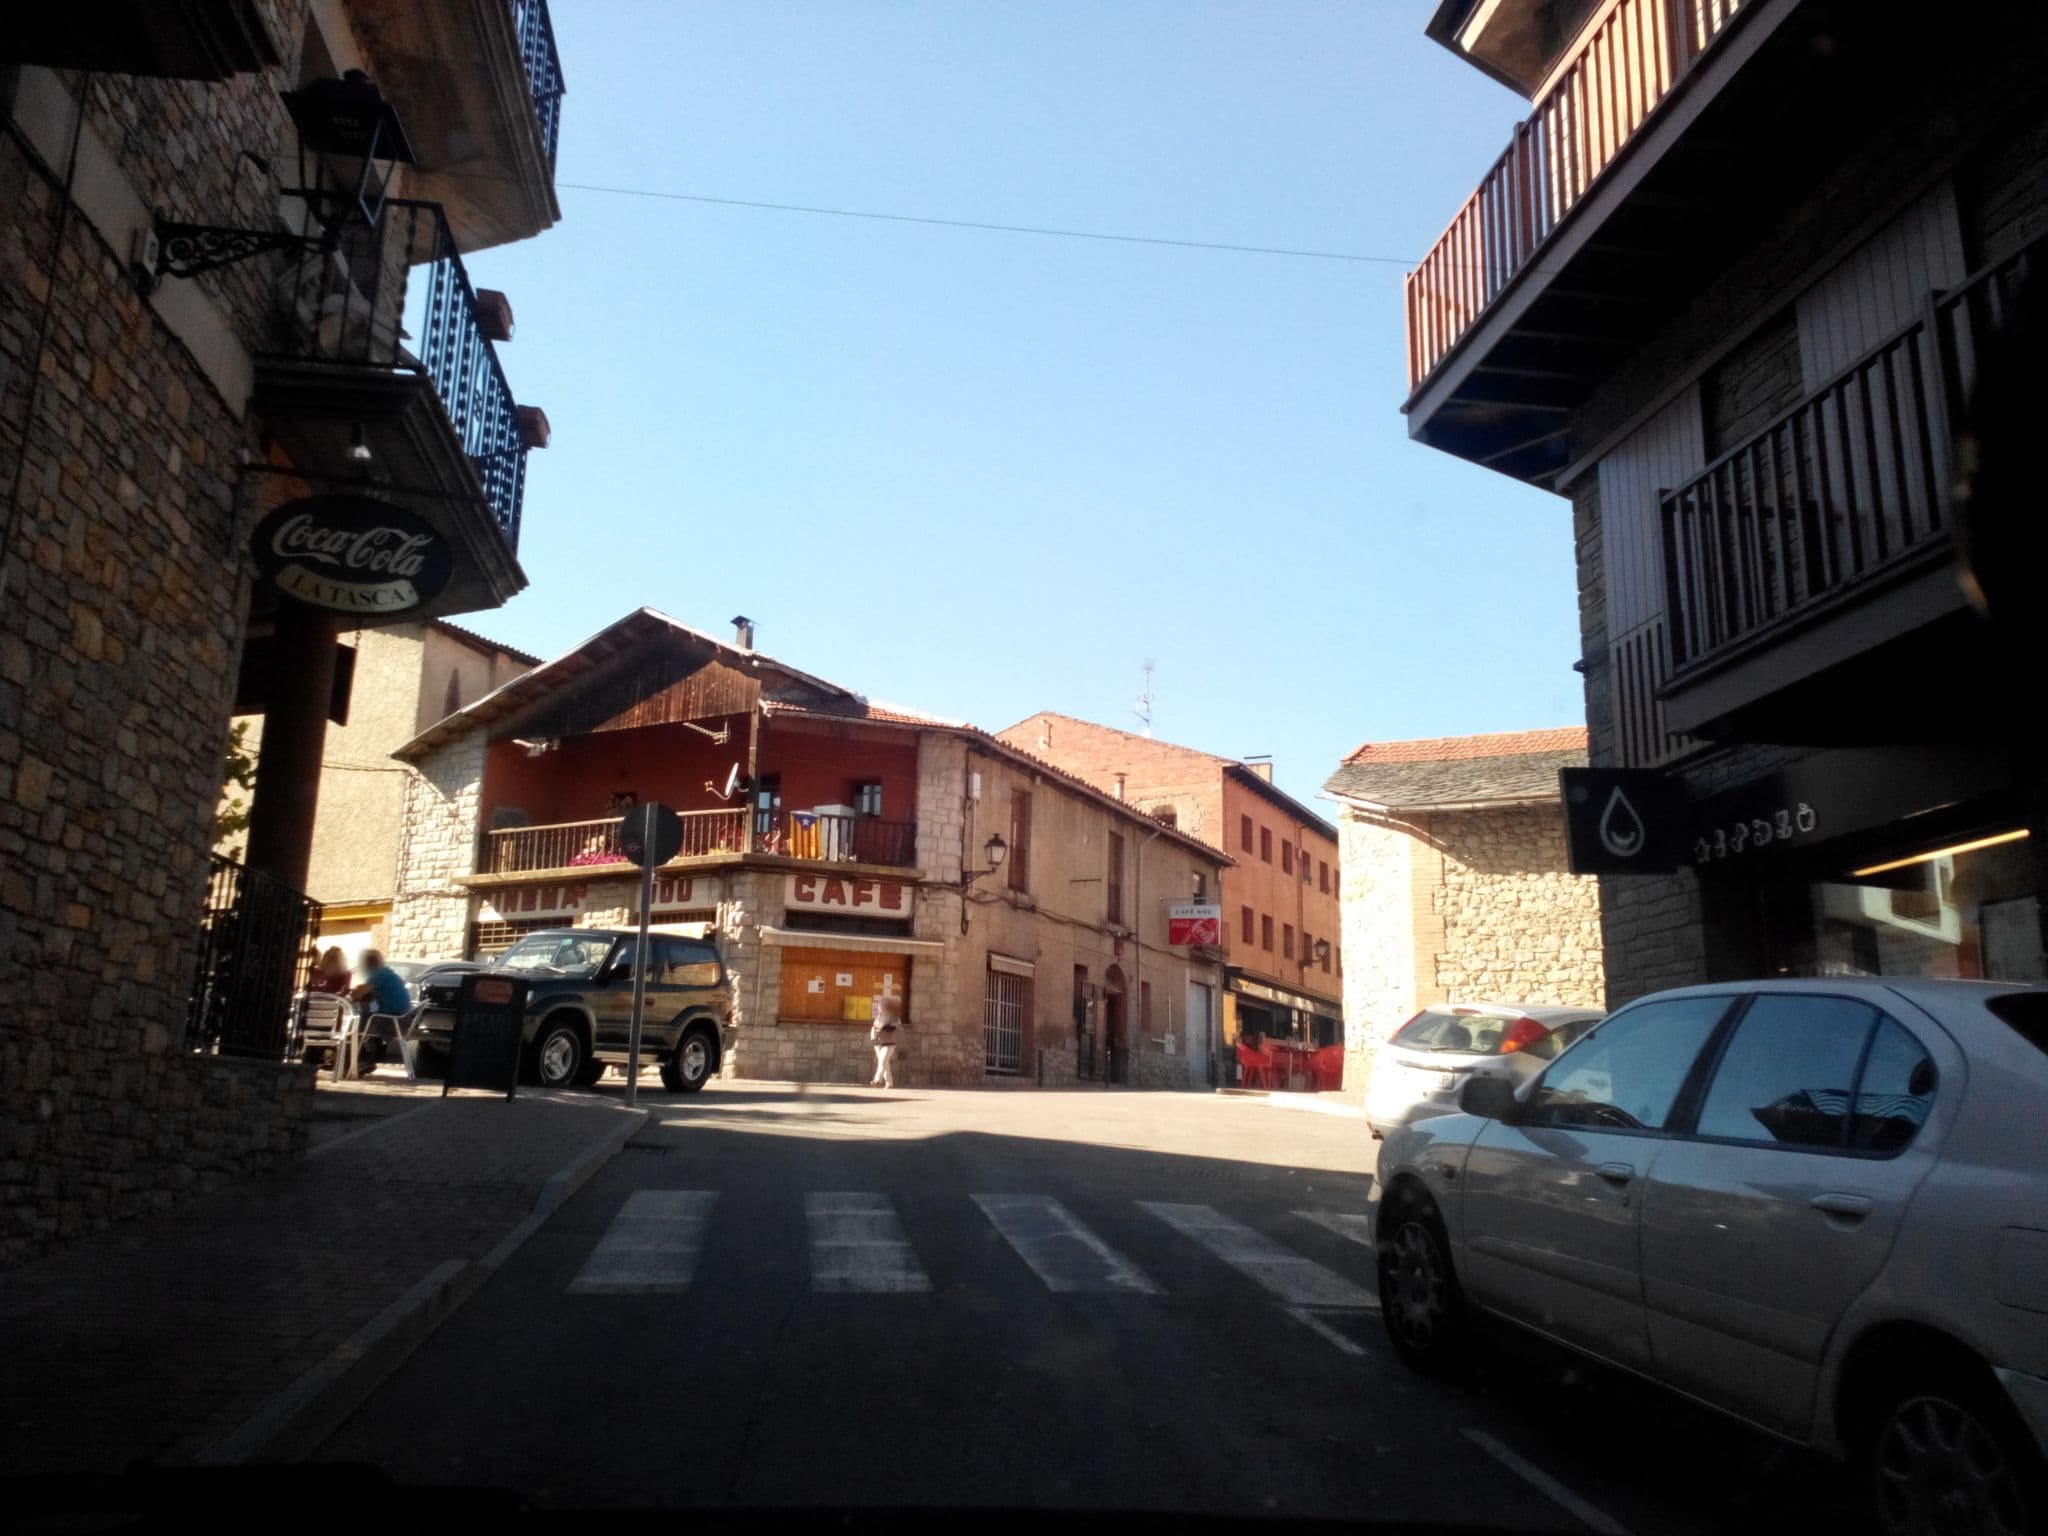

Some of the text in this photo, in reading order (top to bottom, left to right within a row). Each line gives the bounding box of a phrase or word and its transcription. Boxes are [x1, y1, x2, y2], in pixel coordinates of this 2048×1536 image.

[272, 512, 434, 577] Coca-Cola
[292, 573, 407, 607] LA TASCA
[794, 875, 902, 910] CAFE
